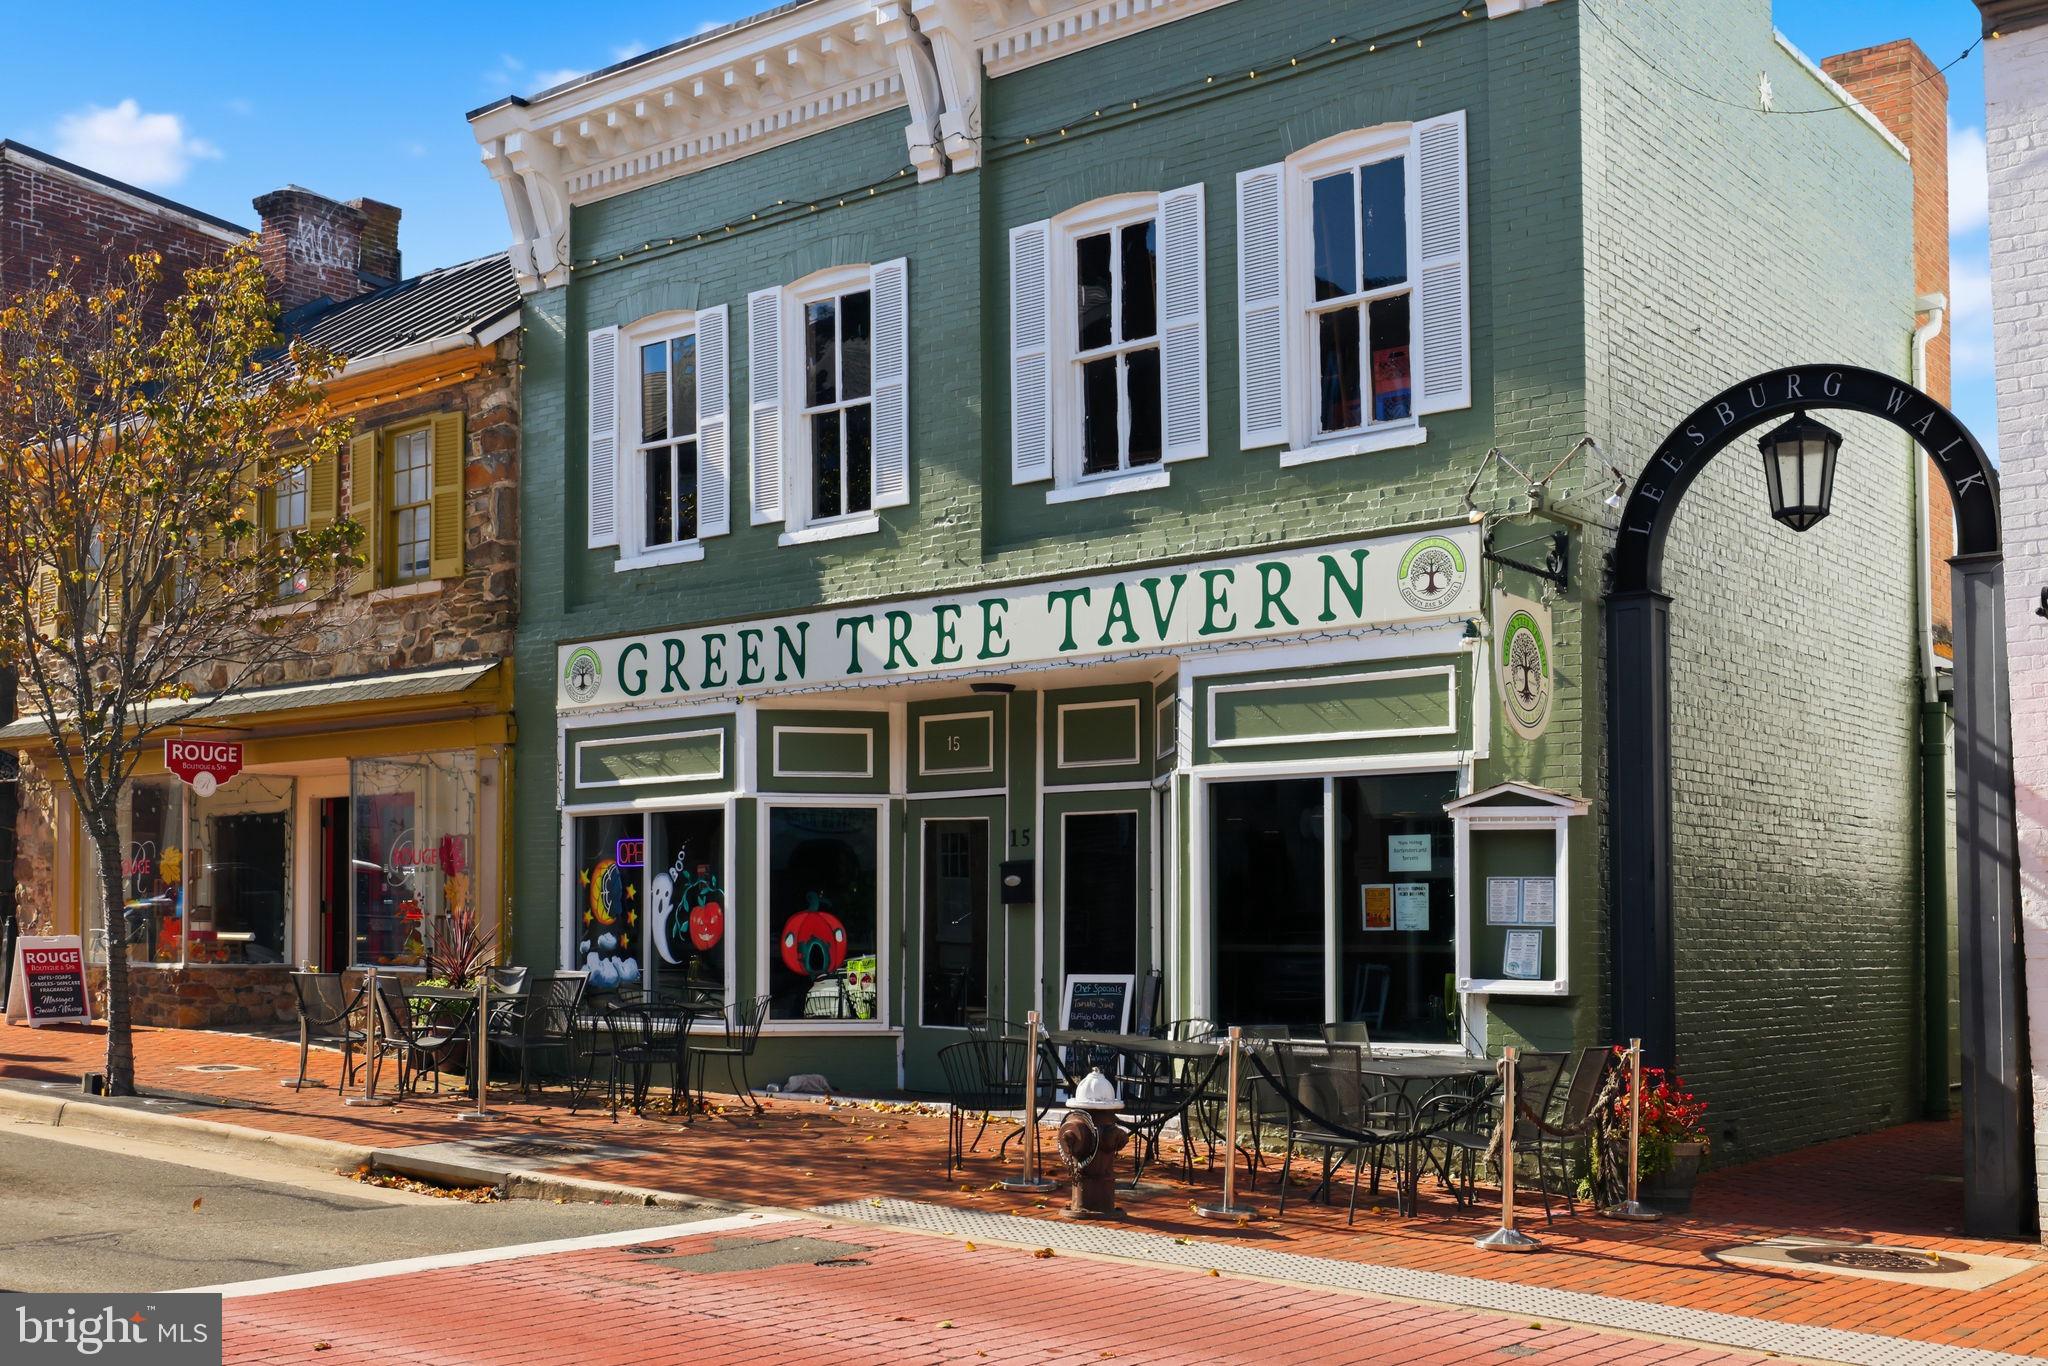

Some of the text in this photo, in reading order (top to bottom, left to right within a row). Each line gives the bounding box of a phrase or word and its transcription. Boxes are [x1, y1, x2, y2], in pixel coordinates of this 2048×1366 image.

[1627, 372, 1986, 536] LEESBURG WALK
[617, 621, 810, 697] GREEN
[835, 597, 1011, 674] TREE
[1047, 548, 1371, 652] TAVERN
[947, 735, 960, 751] 15
[172, 744, 237, 762] ROUGE
[1010, 828, 1031, 847] 15
[393, 847, 438, 865] ROUGE
[25, 952, 79, 964] ROUGE
